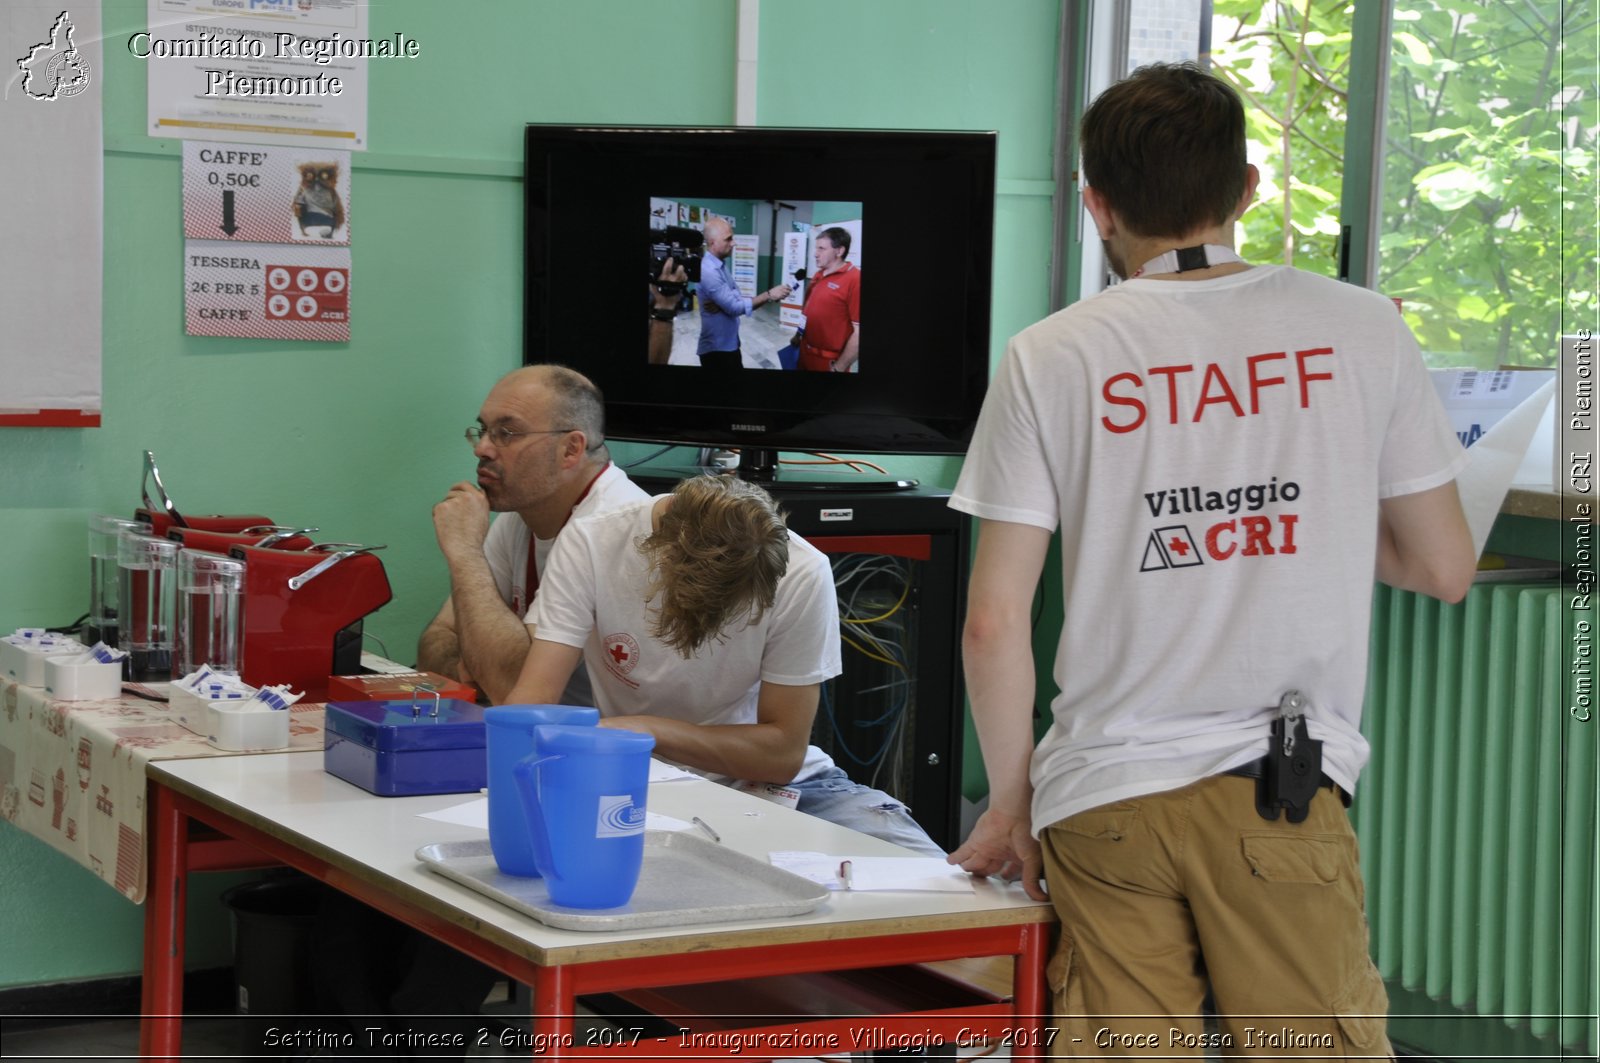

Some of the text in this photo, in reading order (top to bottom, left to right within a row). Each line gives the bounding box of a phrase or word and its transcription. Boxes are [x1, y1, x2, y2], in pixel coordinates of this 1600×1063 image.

[185, 24, 224, 35] ISTITUTO
[199, 149, 268, 166] CAFFE'
[208, 171, 261, 189] 0,50€
[190, 255, 261, 270] TESSERA
[191, 281, 210, 294] 2€
[215, 282, 246, 295] PER
[250, 284, 260, 296] 5
[1101, 347, 1334, 434] STAFF
[731, 423, 767, 433] SAMSUNG
[1144, 476, 1300, 518] Villaggio
[1204, 514, 1299, 561] CRI
